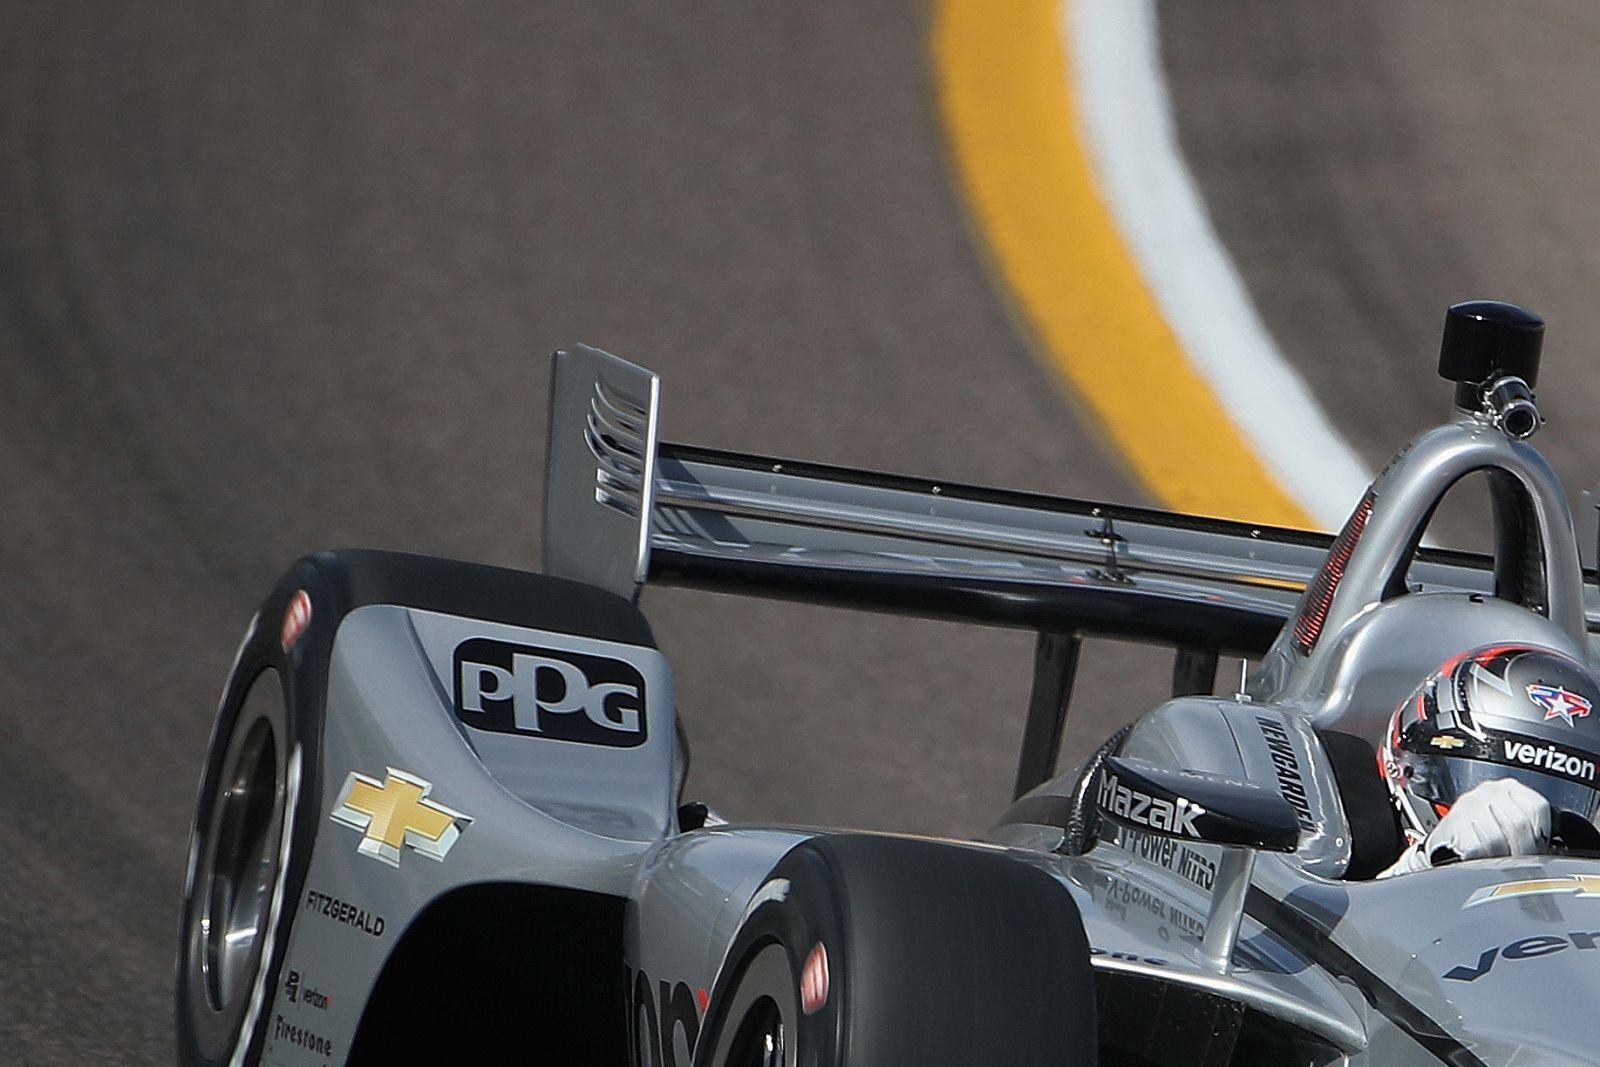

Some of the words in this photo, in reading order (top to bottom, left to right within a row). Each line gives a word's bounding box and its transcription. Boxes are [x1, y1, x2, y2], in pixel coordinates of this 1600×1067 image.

[461, 652, 641, 734] PPG
[1504, 739, 1597, 782] verizon
[1097, 768, 1207, 839] Mazak
[305, 889, 386, 938] FITZGERALD
[275, 1014, 333, 1057] Firestone
